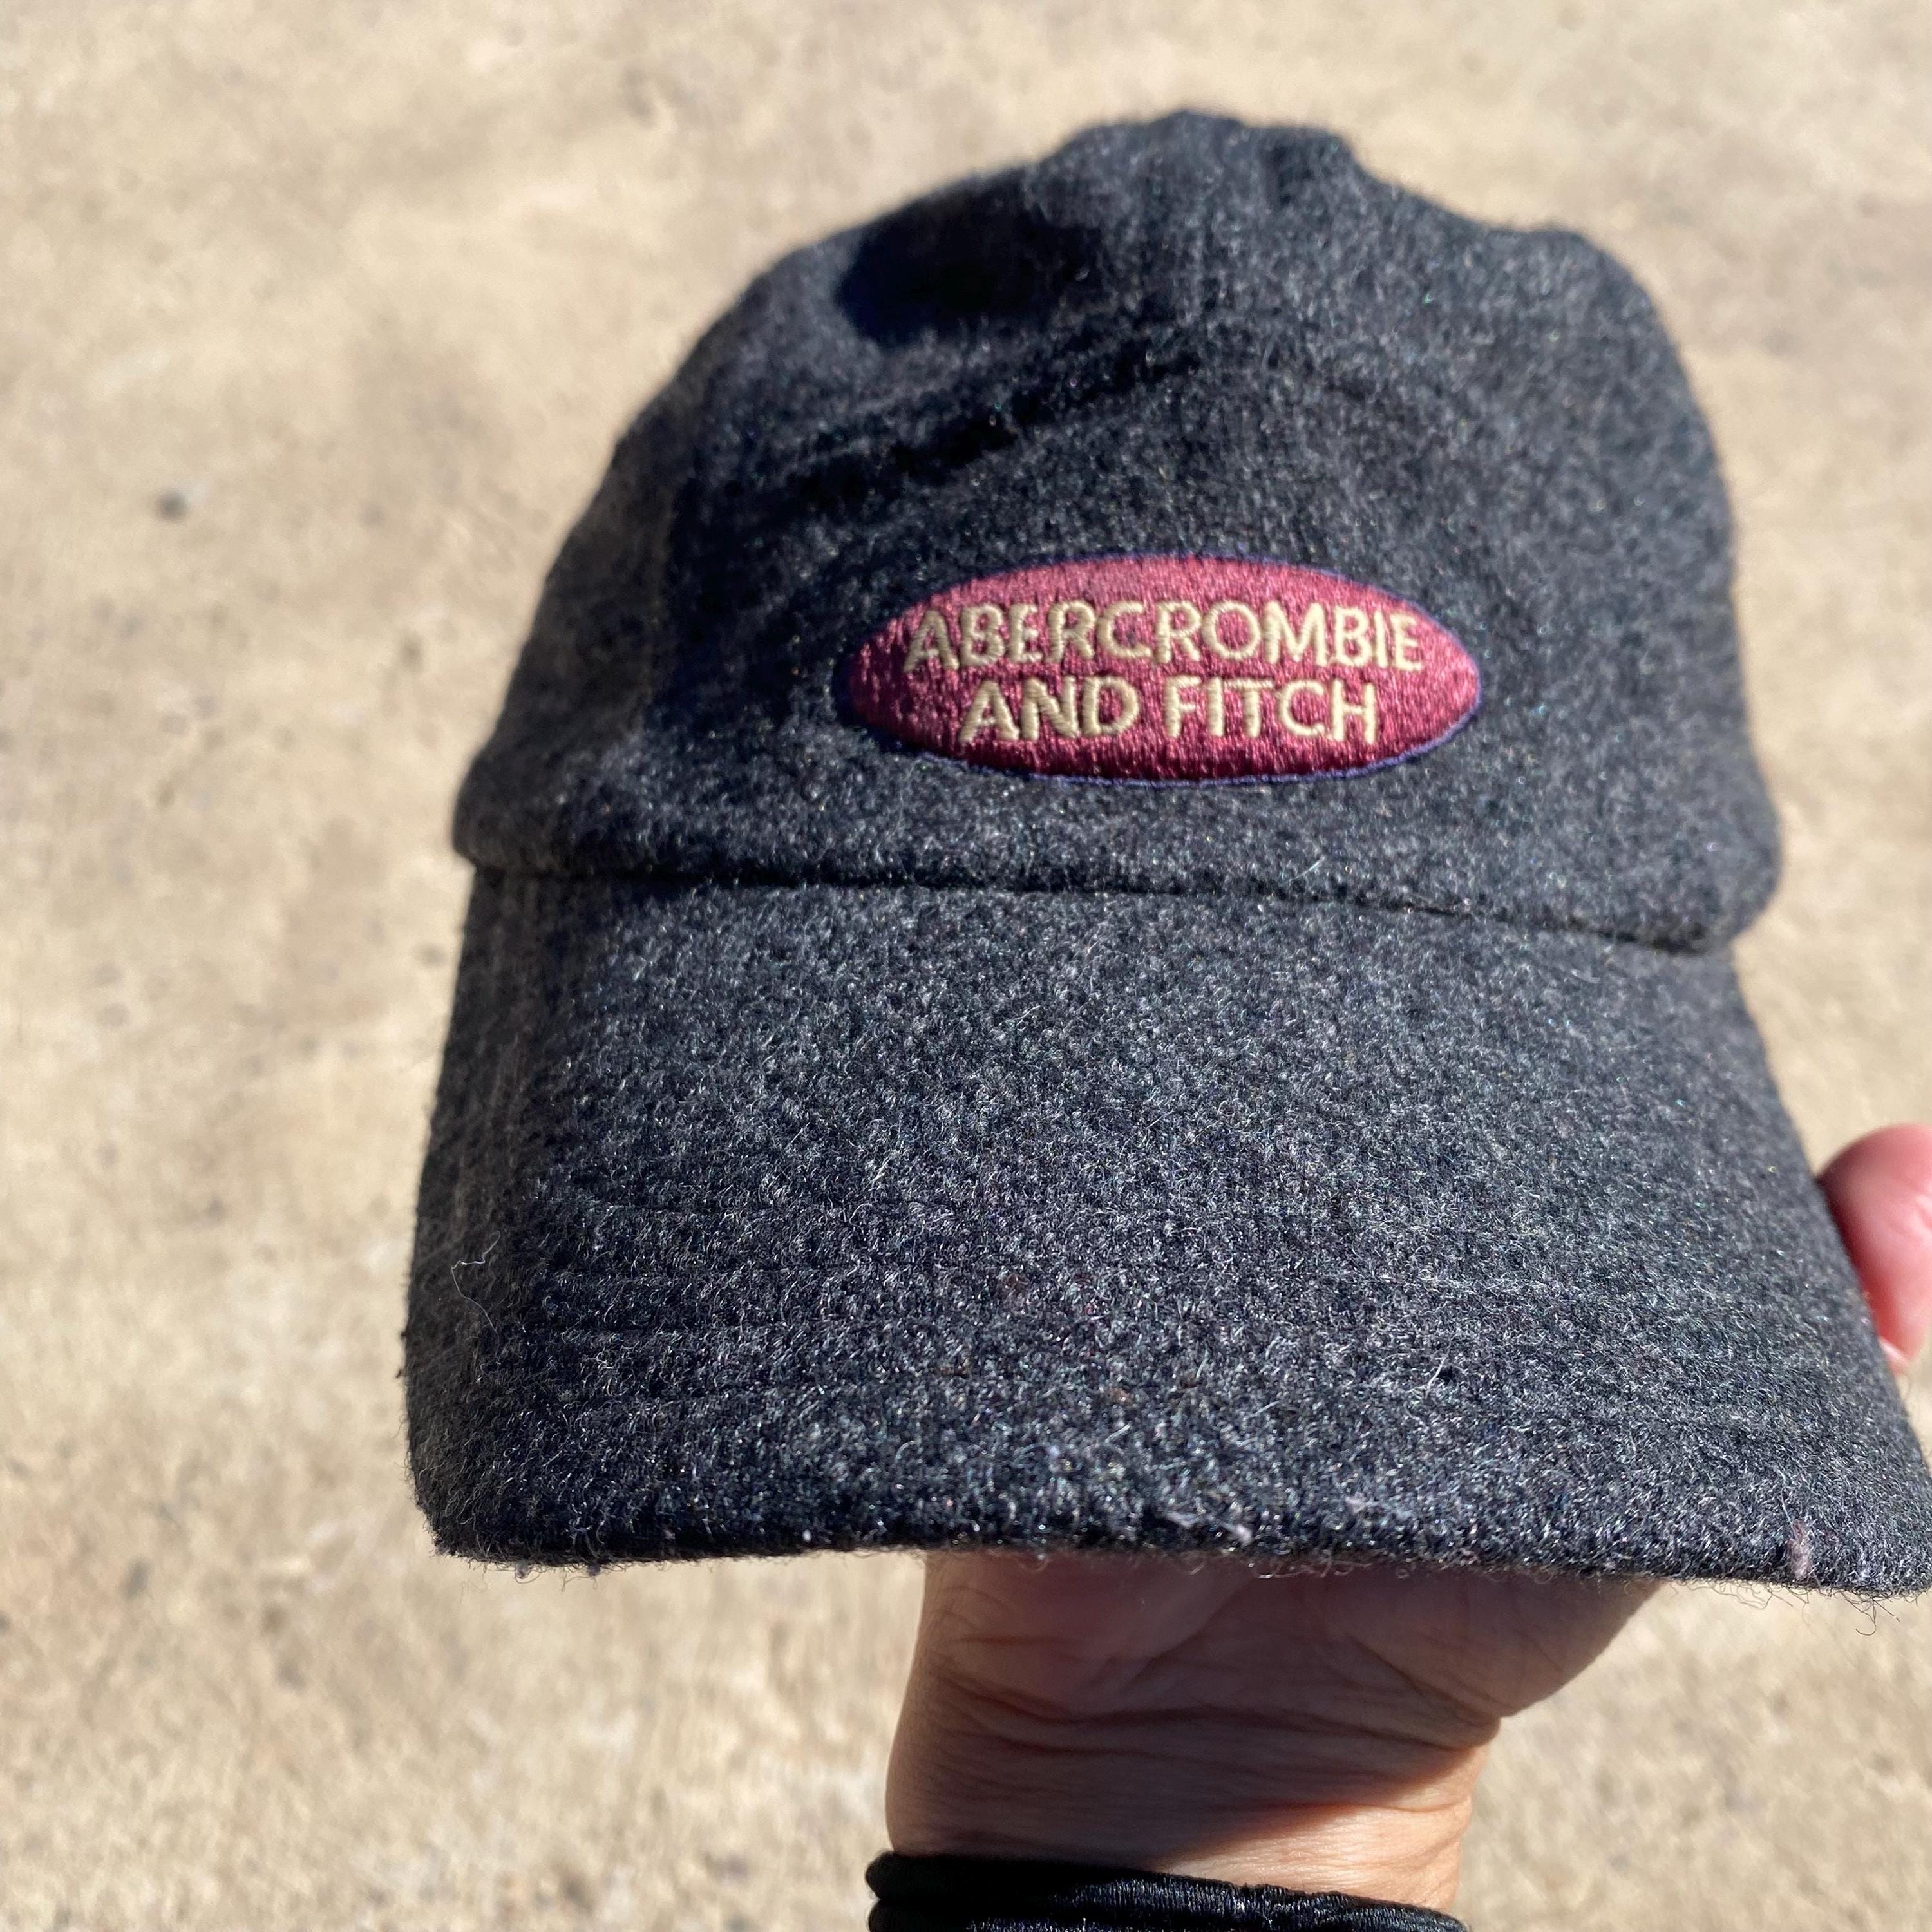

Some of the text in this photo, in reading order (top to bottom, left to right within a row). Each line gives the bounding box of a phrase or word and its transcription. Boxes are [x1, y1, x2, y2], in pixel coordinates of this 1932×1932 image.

[903, 600, 1425, 672] ABERCROMBIE
[959, 676, 1377, 744] AND FITCH
